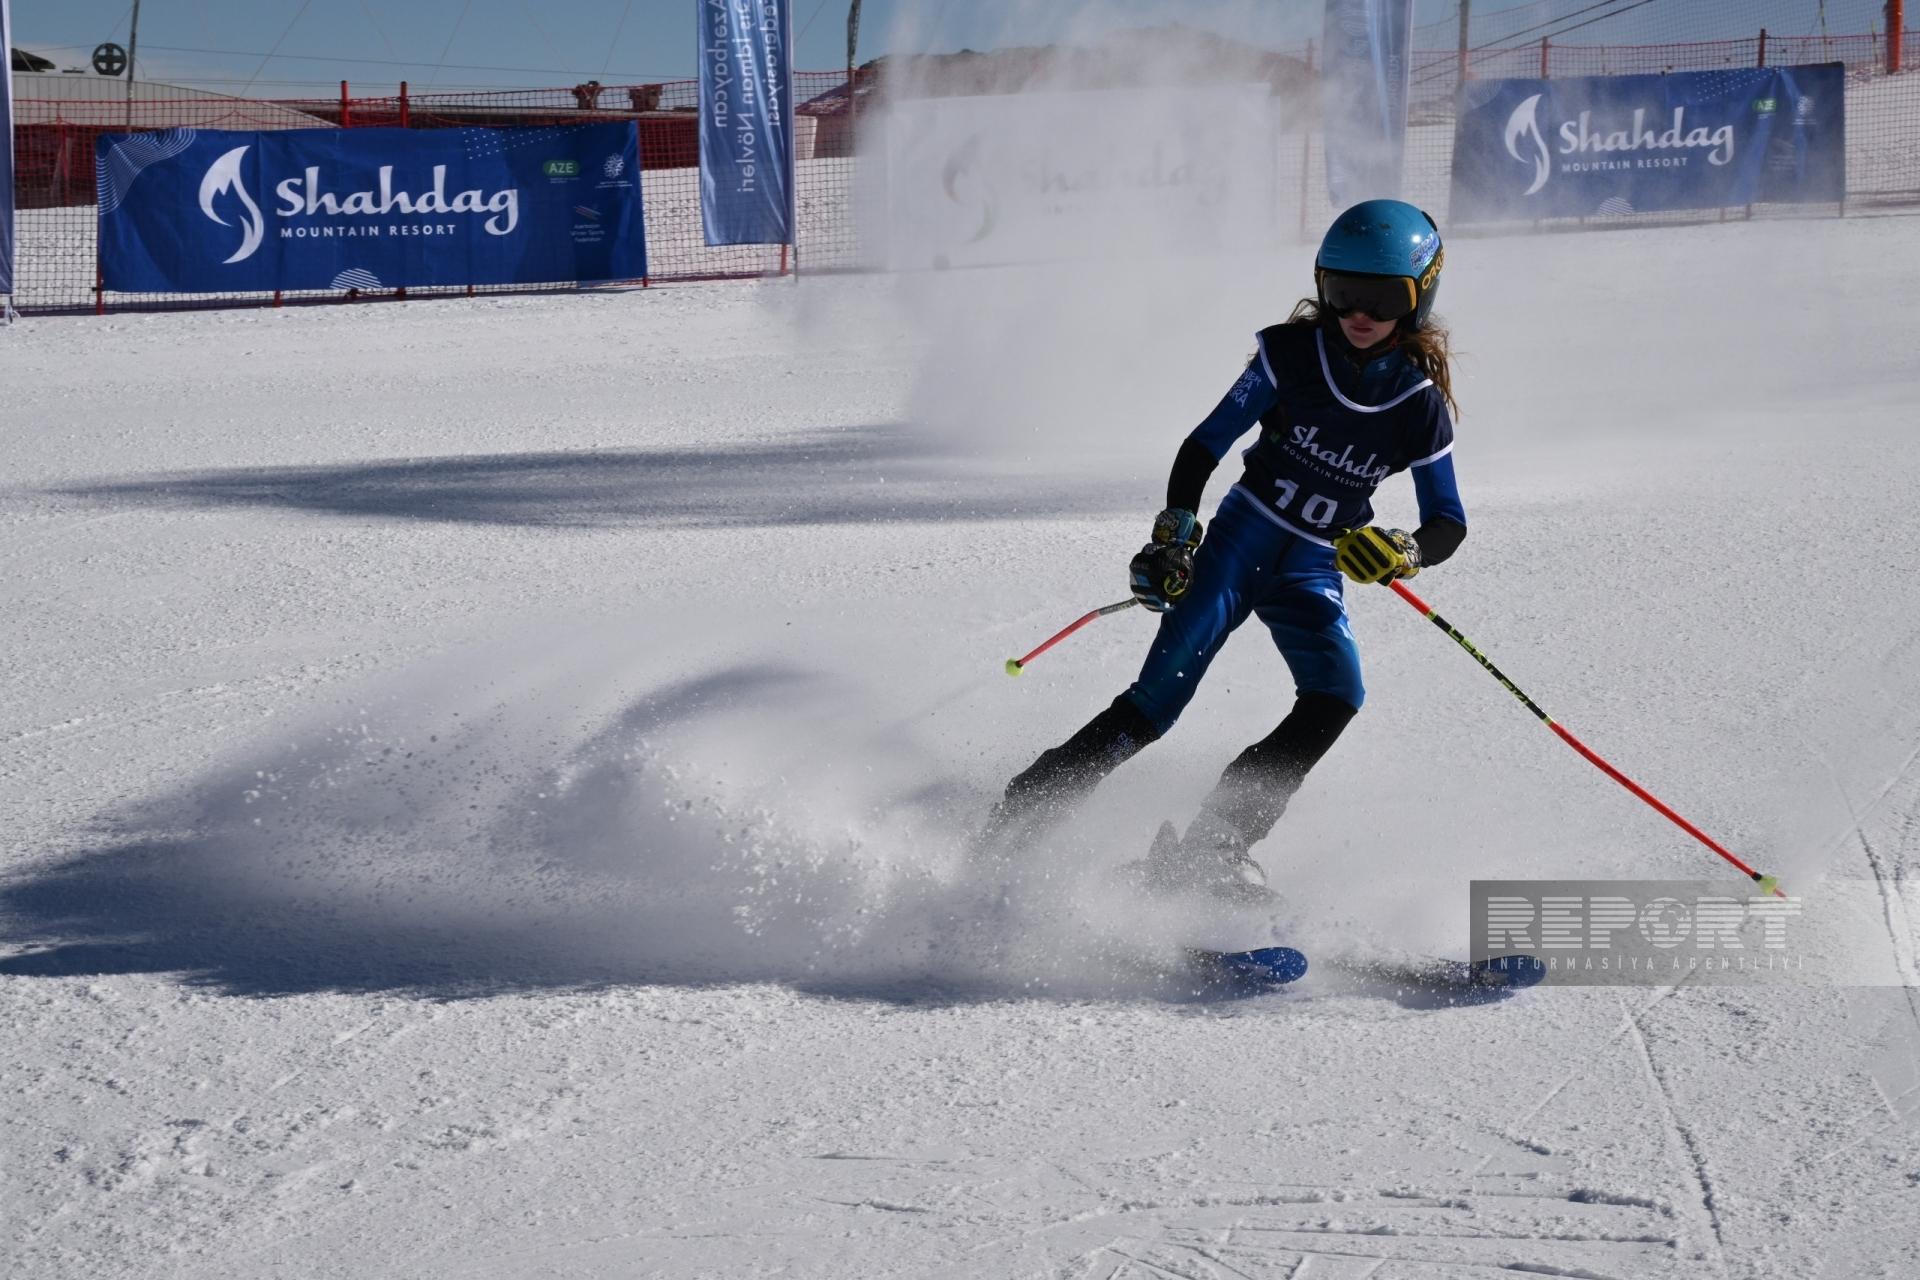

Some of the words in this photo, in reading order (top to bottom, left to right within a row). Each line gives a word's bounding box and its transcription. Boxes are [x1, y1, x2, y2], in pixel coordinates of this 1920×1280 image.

[1559, 106, 1734, 166] Shahdag
[548, 162, 574, 174] AZE
[1561, 159, 1631, 173] MOUNTAIN
[1636, 157, 1689, 169] RESORT
[276, 164, 519, 236] Shahdag
[280, 225, 380, 238] MOUNTAIN
[388, 224, 456, 236] RESORT
[1282, 443, 1332, 479] MOUNTAIN
[1334, 475, 1364, 489] RESORT
